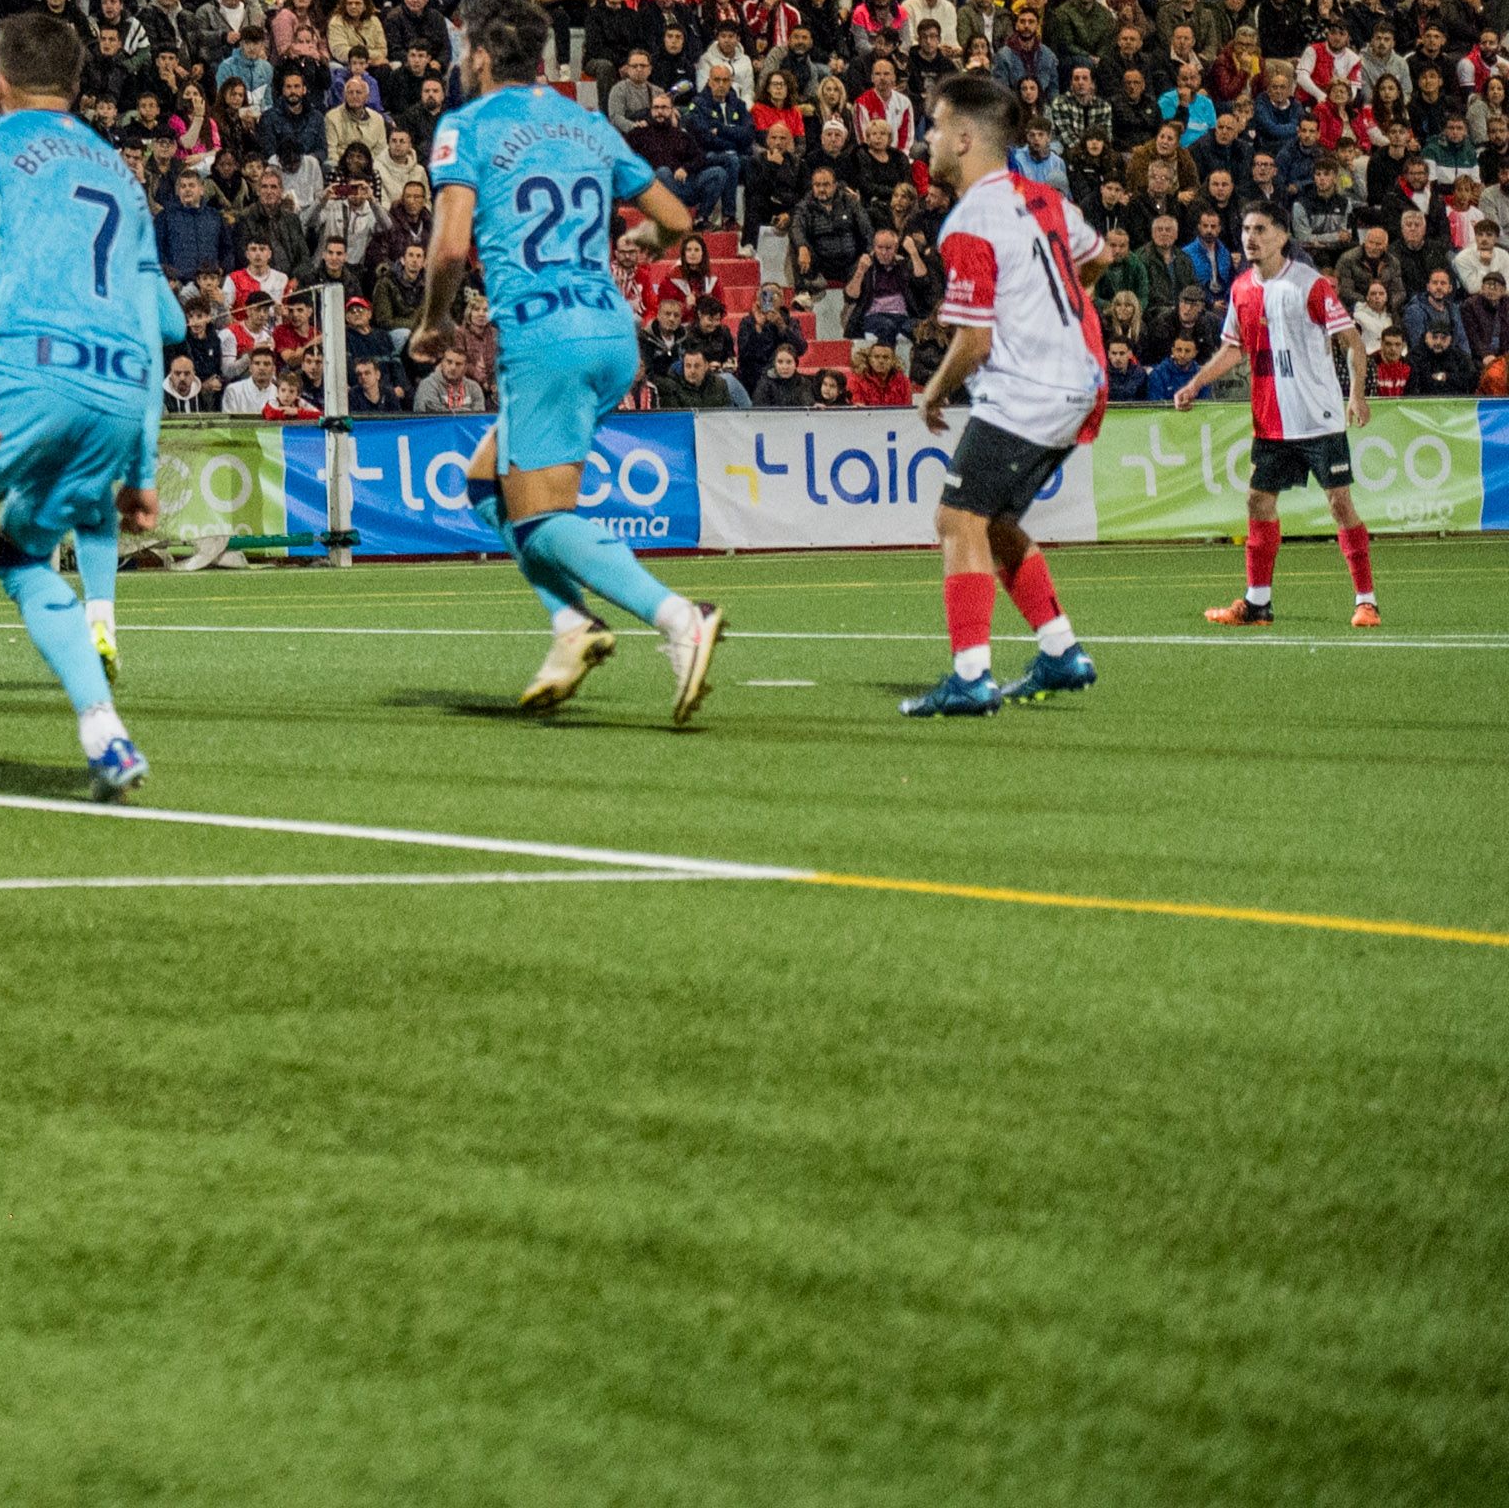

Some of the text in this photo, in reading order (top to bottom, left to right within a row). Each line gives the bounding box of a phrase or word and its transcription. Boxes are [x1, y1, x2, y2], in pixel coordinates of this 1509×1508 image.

[73, 184, 121, 299] 7
[515, 175, 605, 276] 22
[1031, 229, 1085, 327] 10
[37, 334, 149, 387] DIG
[397, 435, 670, 511] laco
[804, 431, 1064, 506] lain
